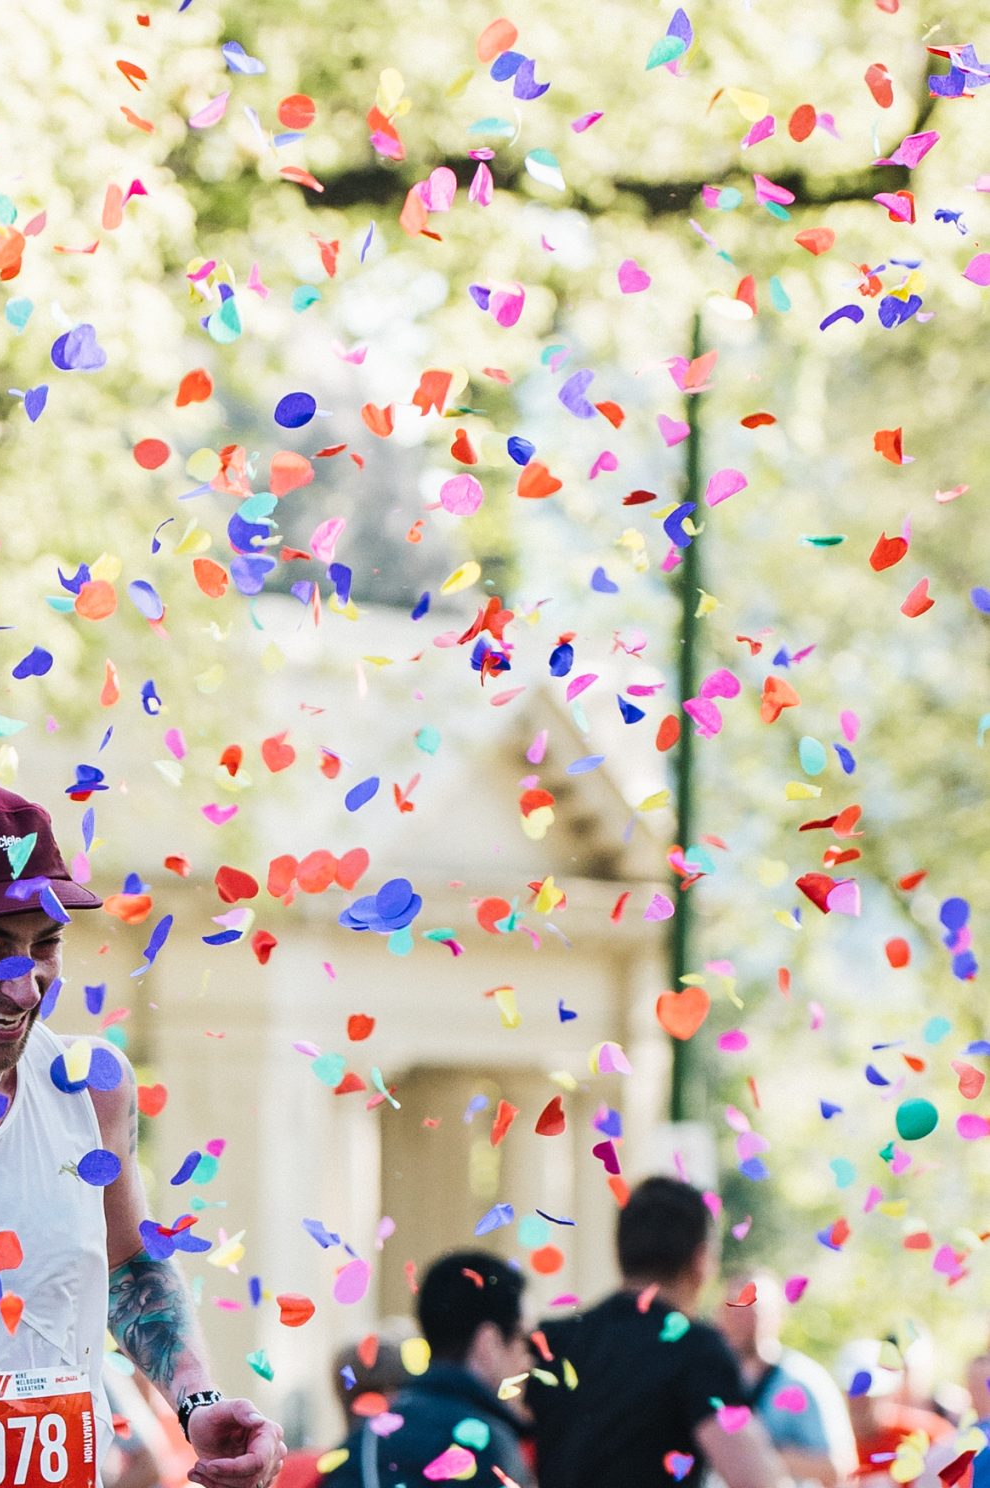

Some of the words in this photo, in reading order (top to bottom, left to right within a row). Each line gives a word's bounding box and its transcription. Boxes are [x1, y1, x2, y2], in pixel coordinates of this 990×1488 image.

[15, 1377, 47, 1386] MELBOURNE
[16, 1384, 45, 1392] MARATHON
[81, 1411, 93, 1463] MARATHON
